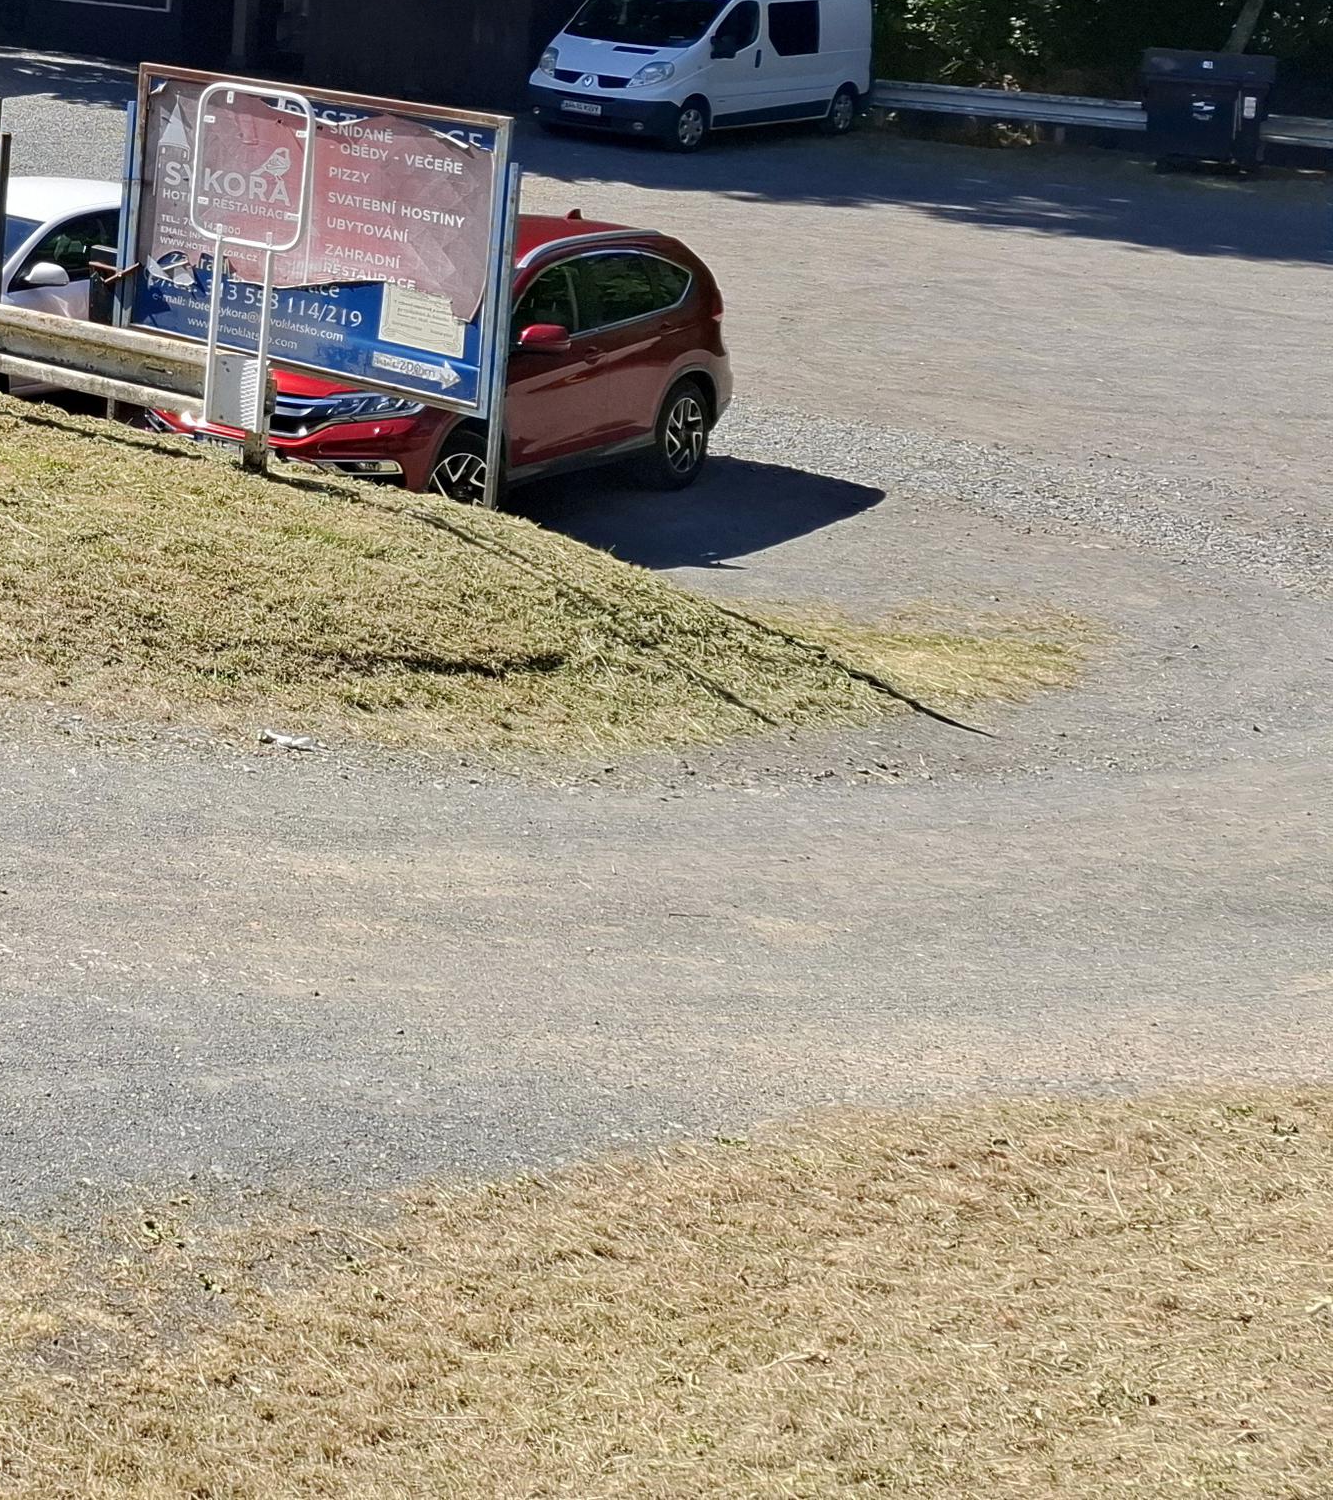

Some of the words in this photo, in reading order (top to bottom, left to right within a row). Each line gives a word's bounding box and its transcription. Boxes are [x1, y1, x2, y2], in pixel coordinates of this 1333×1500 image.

[329, 123, 394, 144] SNÍDANĚ
[340, 143, 388, 162] OBĚDY
[405, 153, 463, 175] VEČEŘE
[329, 166, 371, 184] PIZZY
[328, 191, 397, 215] SVATEBNÍ
[401, 204, 466, 228] HOSTINY
[326, 216, 409, 244] UBYTOVÁNÍ
[324, 243, 401, 269] ZAHRADNÍ
[287, 296, 362, 327] 114/219
